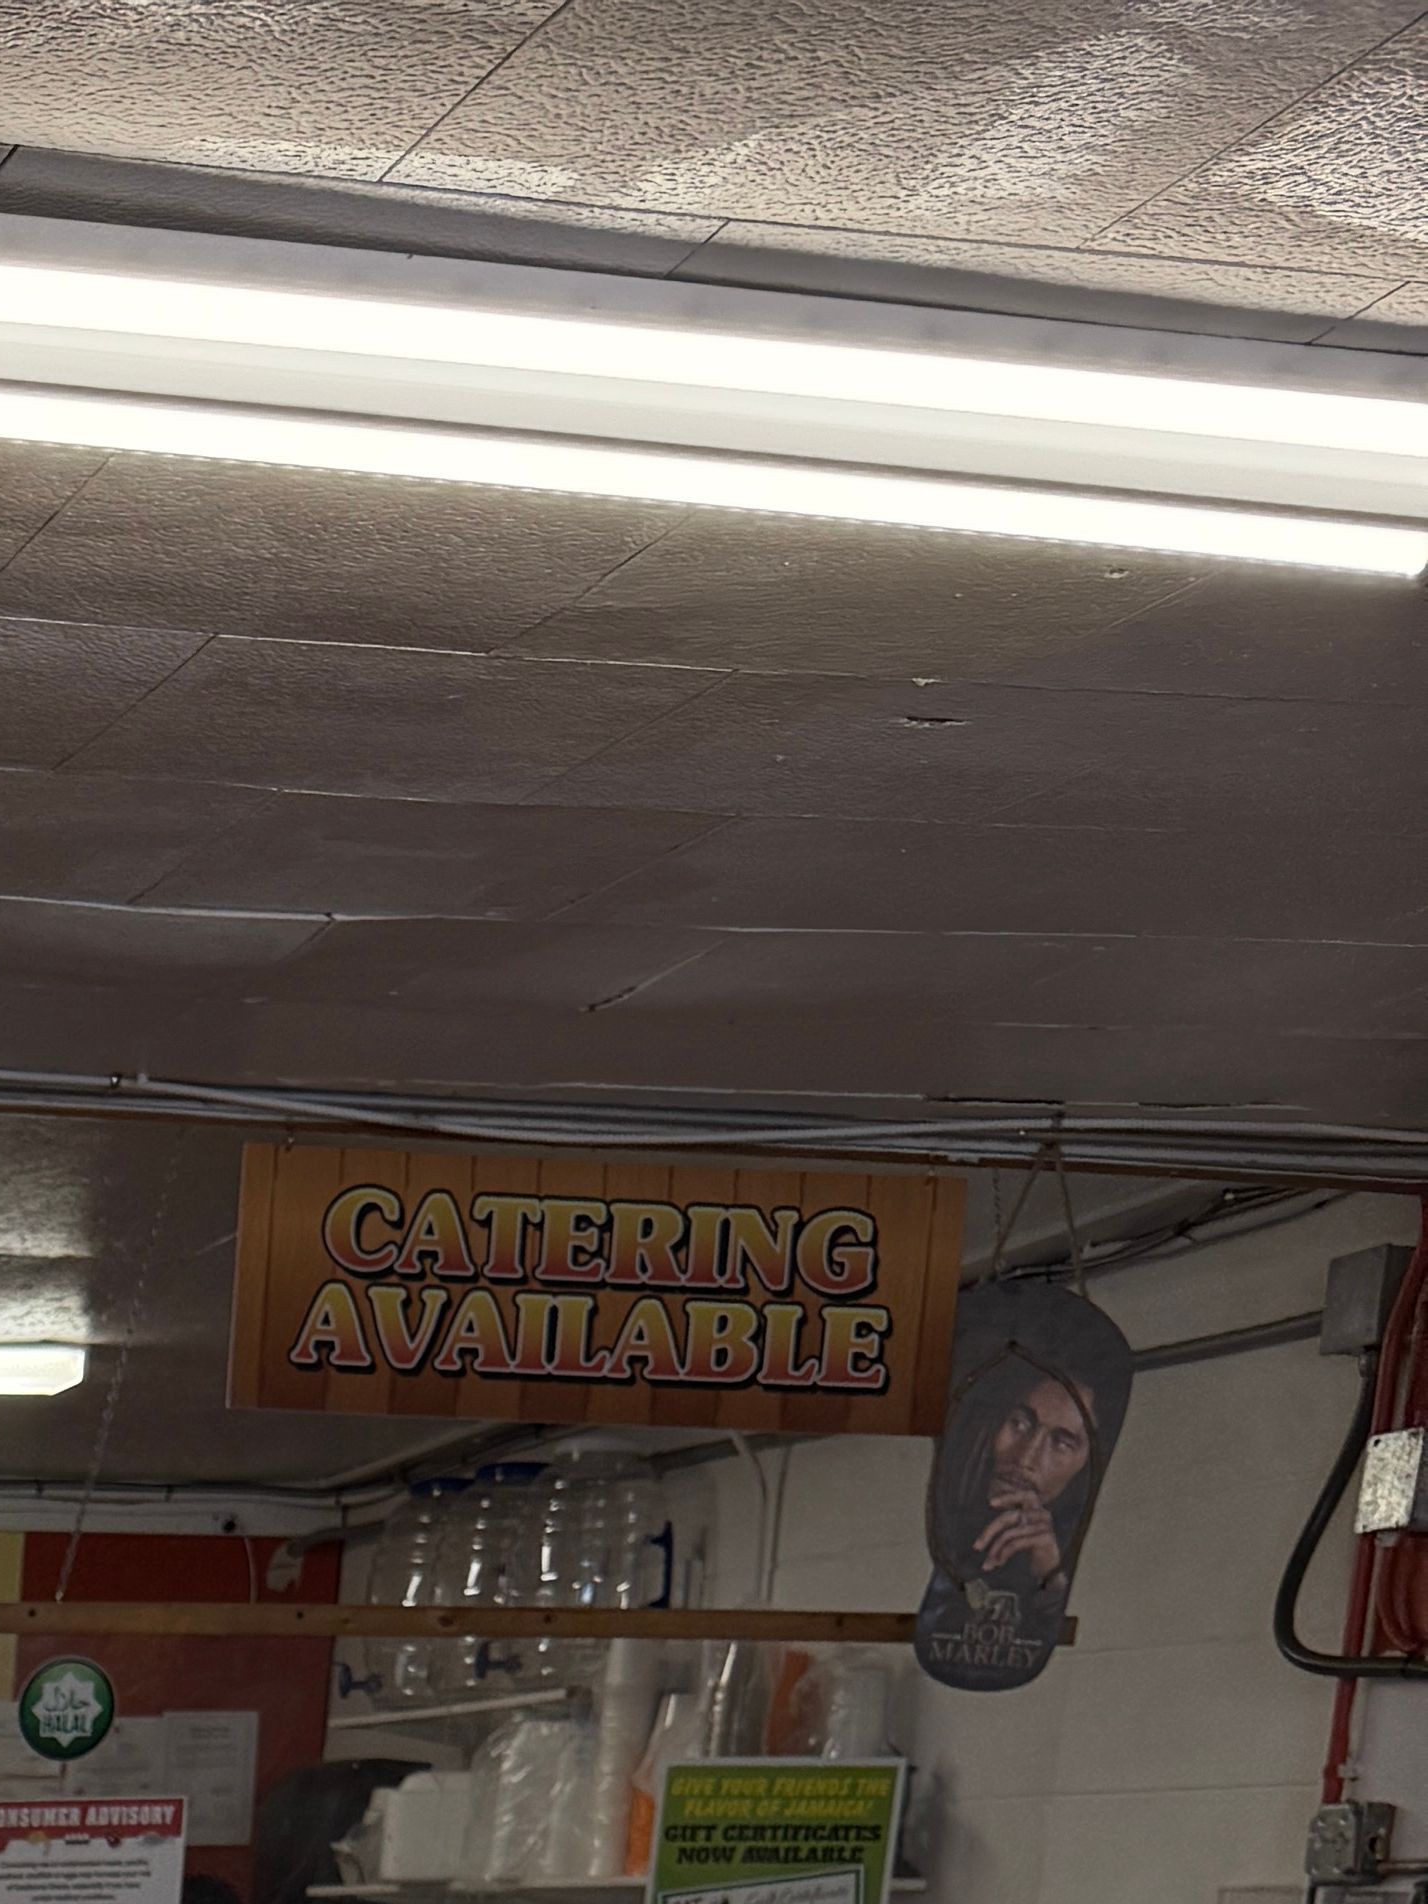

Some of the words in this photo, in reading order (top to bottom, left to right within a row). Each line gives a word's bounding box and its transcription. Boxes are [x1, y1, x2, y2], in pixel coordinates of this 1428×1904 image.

[322, 1185, 877, 1298] CATERING
[289, 1281, 890, 1392] AVAILABLE
[962, 1623, 1015, 1645] BOB
[930, 1641, 1040, 1668] MARLEY
[40, 1715, 90, 1735] HALAL
[671, 1778, 714, 1797] GIVE
[719, 1777, 768, 1797] YOUR
[772, 1777, 850, 1797] FRIENDS
[855, 1778, 891, 1797] THE
[85, 1804, 175, 1826] ADVISORY
[684, 1800, 753, 1818] FLAVOR
[756, 1800, 780, 1818] OF
[665, 1825, 717, 1842] GIFT
[722, 1824, 882, 1842] CERTIFICATES
[676, 1846, 736, 1864] NOW
[740, 1846, 865, 1864] AVAILABLE
